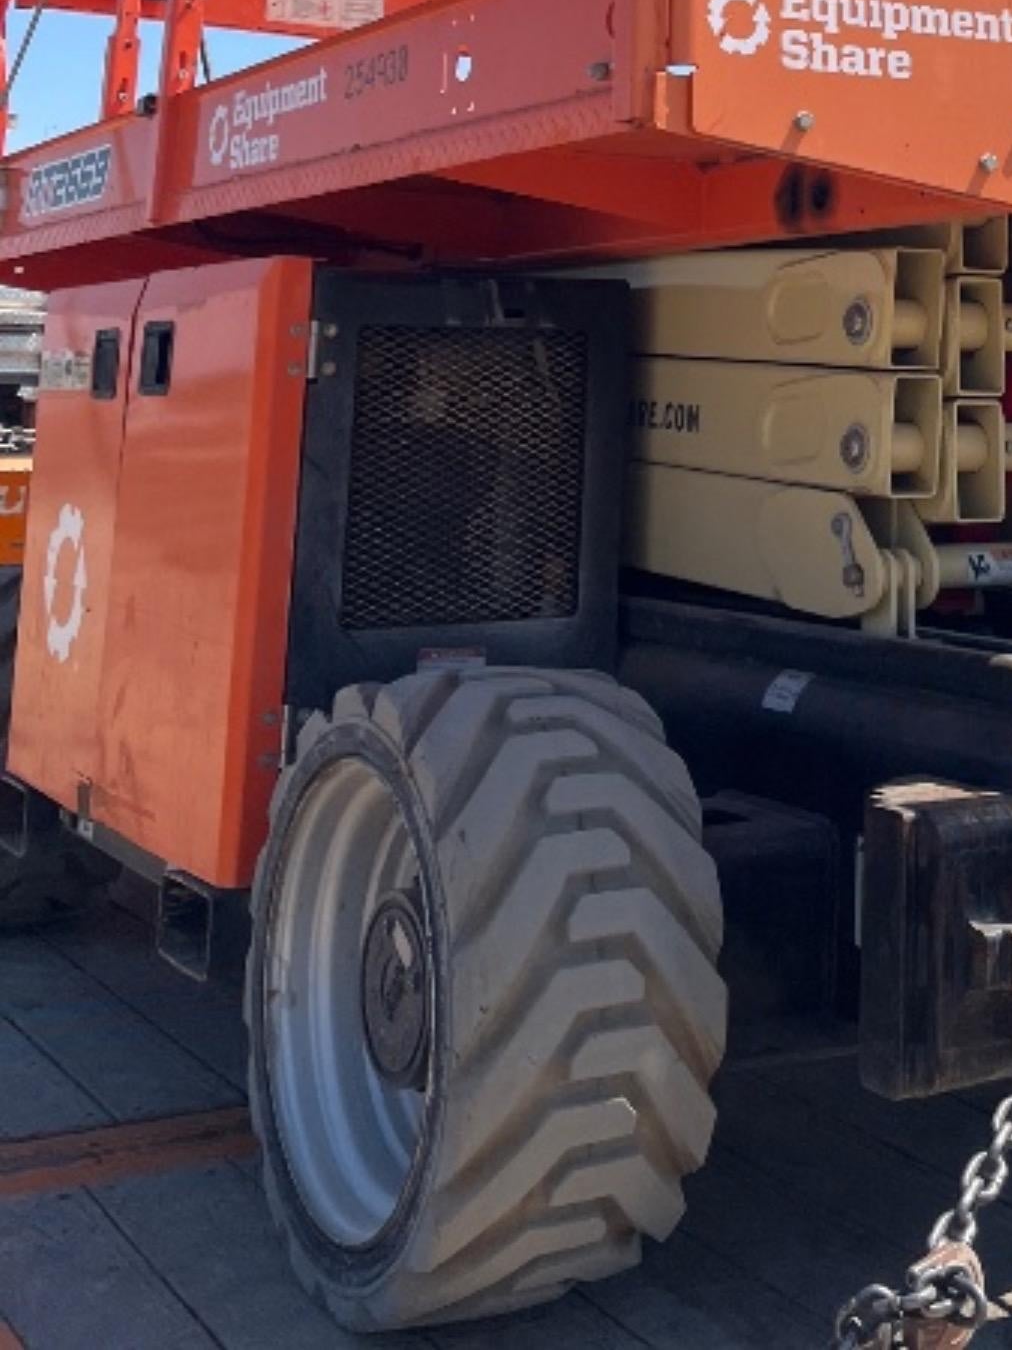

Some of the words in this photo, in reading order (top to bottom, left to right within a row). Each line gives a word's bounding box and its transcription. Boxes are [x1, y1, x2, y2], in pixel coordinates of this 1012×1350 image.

[780, 29, 912, 78] Share
[232, 66, 329, 130] Equipment
[228, 133, 279, 170] Share
